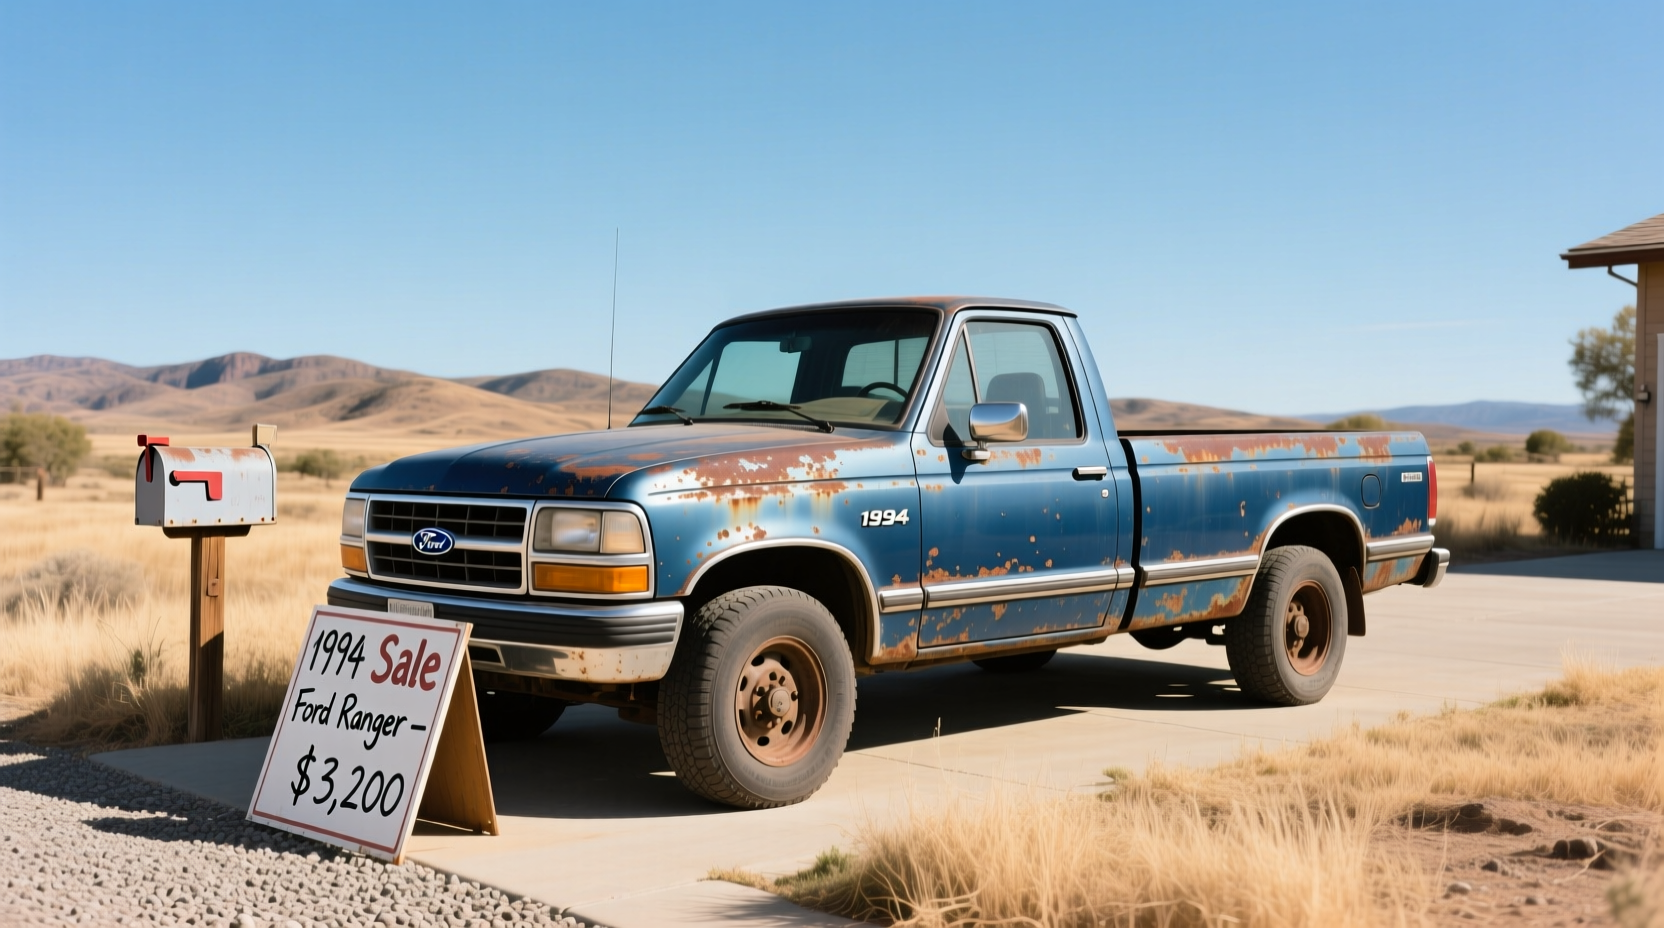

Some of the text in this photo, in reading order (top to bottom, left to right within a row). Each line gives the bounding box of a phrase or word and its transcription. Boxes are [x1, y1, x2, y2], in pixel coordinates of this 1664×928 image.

[860, 508, 910, 527] 1994
[309, 629, 442, 692] 1994 Sale
[291, 687, 337, 726] Ford
[336, 692, 408, 751] Ranger
[290, 744, 405, 817] $3,200
